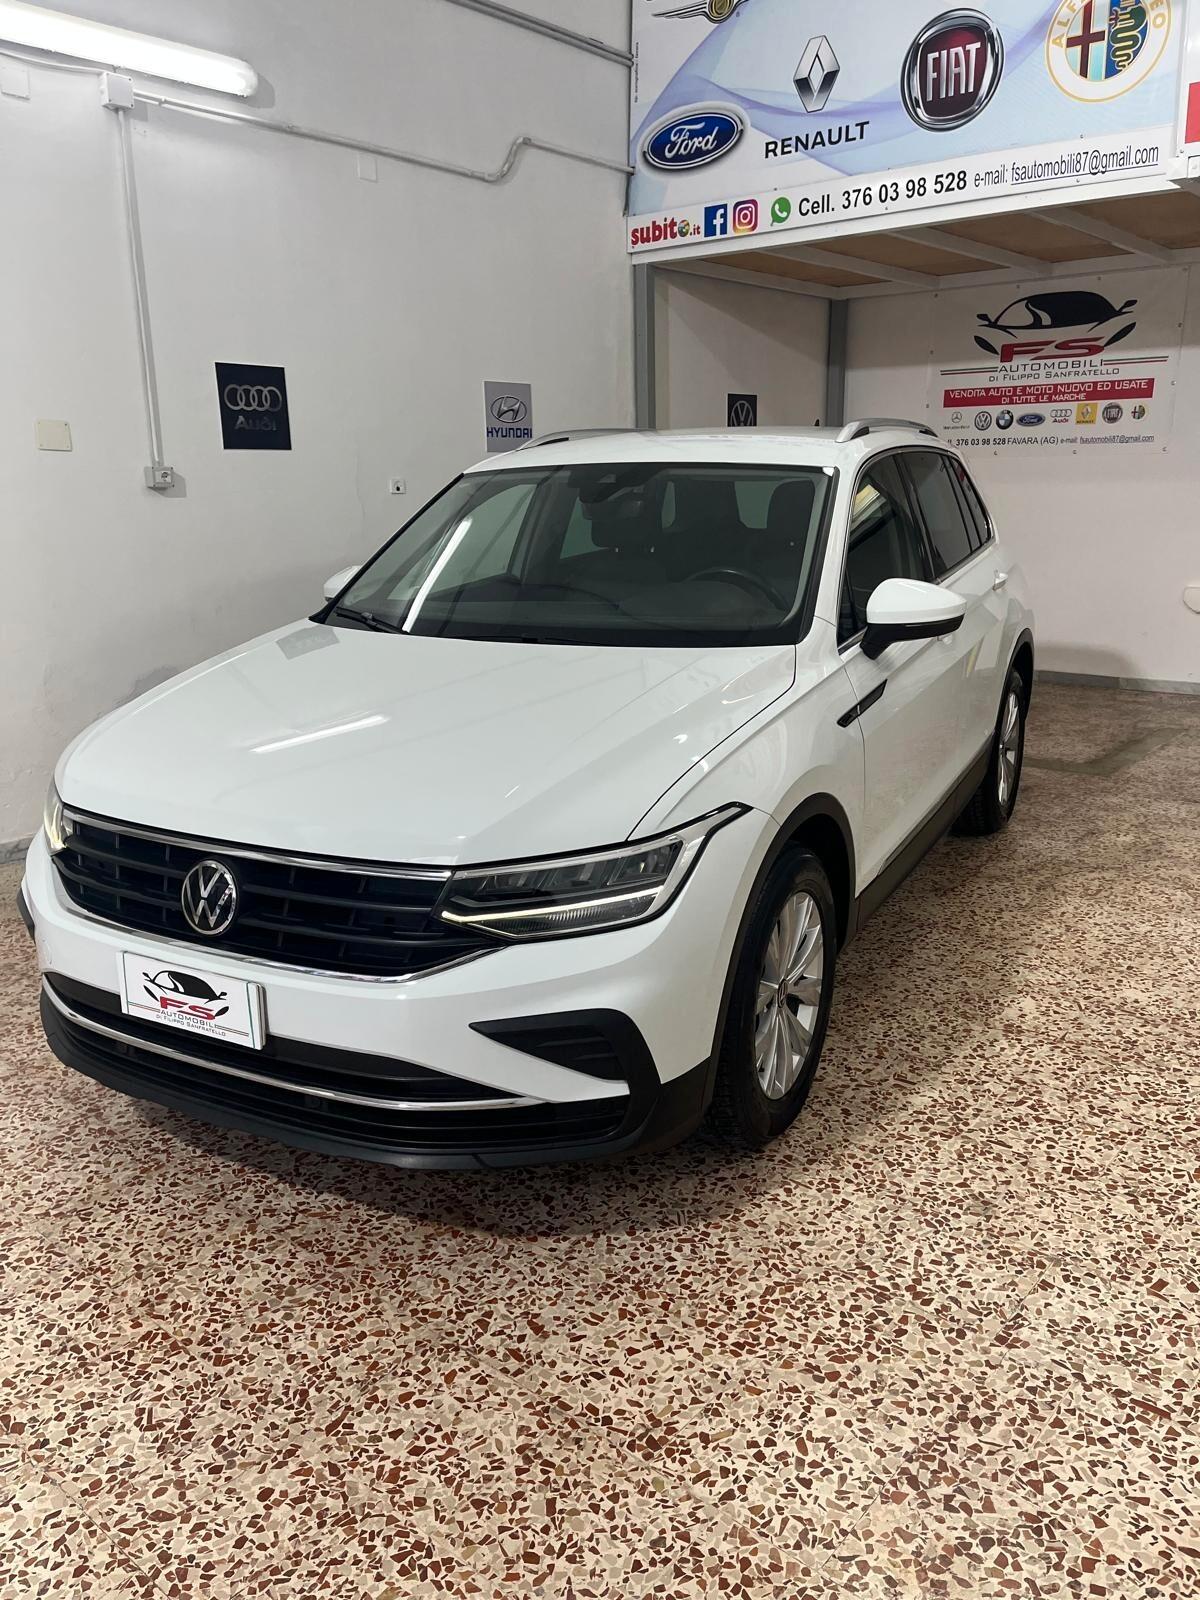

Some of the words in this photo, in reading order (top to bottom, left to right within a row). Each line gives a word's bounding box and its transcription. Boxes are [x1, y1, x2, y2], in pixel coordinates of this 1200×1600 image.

[1051, 0, 1082, 48] ALF
[926, 42, 981, 102] FIAT
[665, 121, 718, 159] Ford
[765, 121, 870, 158] RENAULT
[799, 194, 835, 216] Cell.
[842, 187, 872, 209] 376
[879, 182, 899, 203] 03
[906, 177, 927, 199] 98
[934, 170, 967, 194] 528
[974, 164, 1008, 188] e-mail:
[1011, 146, 1159, 183] fsautomobili87@gmail.com
[1000, 336, 1105, 363] FS
[999, 359, 1104, 373] AUTOMOBILI
[1003, 372, 1040, 381] FILIPPO
[1045, 368, 1120, 379] SANFRATELLO
[949, 389, 986, 398] VENDITA
[988, 387, 1013, 396] AUTO
[1016, 386, 1023, 395] E
[1025, 385, 1053, 394] MOTO
[1057, 383, 1093, 393] NUOVO
[1097, 382, 1111, 391] ED
[1115, 380, 1148, 390] USATE
[1001, 396, 1009, 404] DI
[1012, 395, 1036, 403] TUTTE
[1039, 394, 1049, 402] LE
[1052, 393, 1087, 401] MARCHE
[233, 415, 278, 431] Audi
[486, 426, 533, 439] HYUNDAI
[956, 438, 969, 446] 376
[971, 438, 980, 446] 03
[981, 438, 991, 446] 98
[993, 437, 1006, 446] 528
[1007, 436, 1039, 445] FAVARA
[1040, 435, 1059, 447] (AG)
[160, 996, 216, 1020] FS
